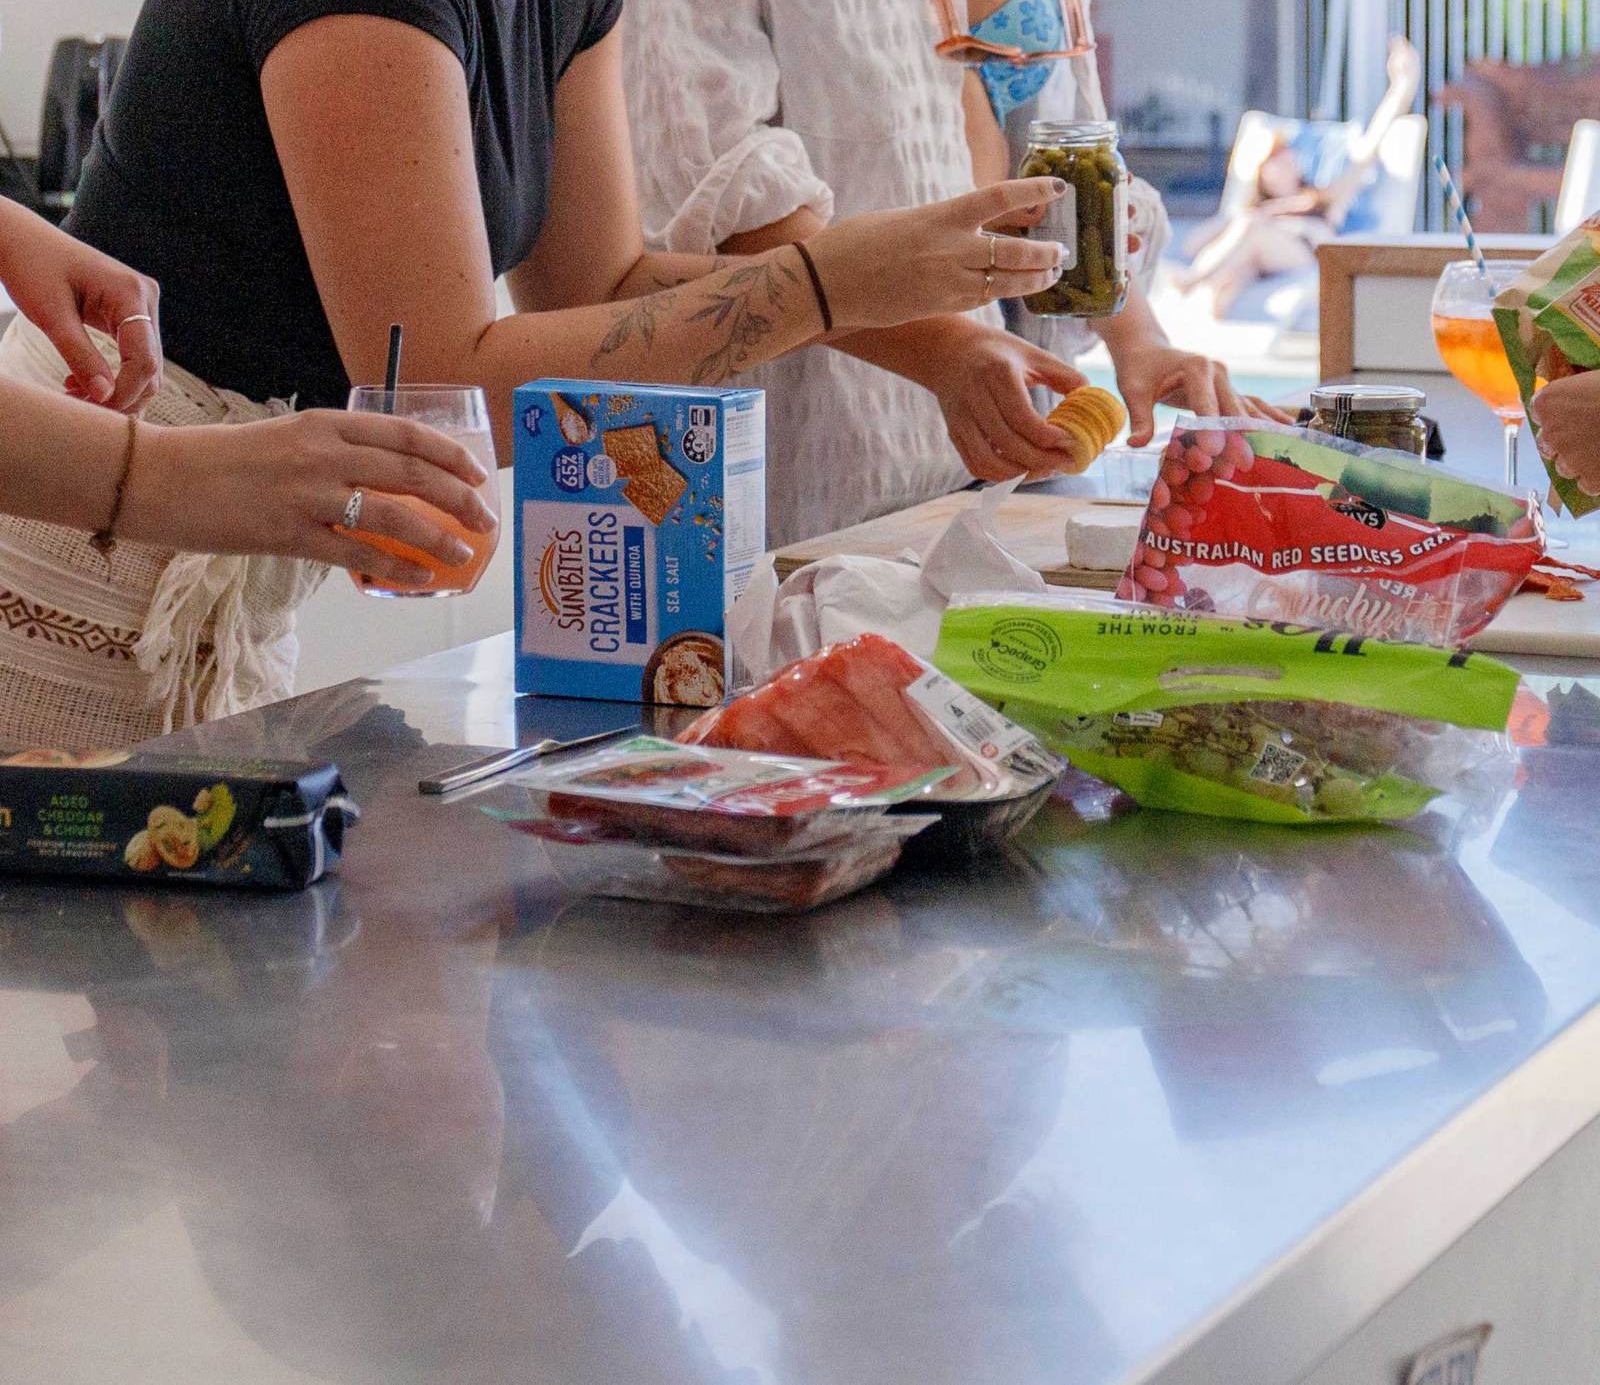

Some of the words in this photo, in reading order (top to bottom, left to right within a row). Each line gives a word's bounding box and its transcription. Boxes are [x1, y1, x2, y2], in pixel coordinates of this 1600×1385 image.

[561, 454, 578, 487] 65%
[1145, 532, 1264, 568] AUSTRALIAN
[1272, 547, 1303, 569] RED
[1310, 544, 1404, 566] SEEDLESS
[1409, 533, 1456, 556] GRA
[556, 530, 585, 632] SUNBITES
[628, 545, 642, 589] QUINOA
[665, 555, 680, 585] SALT
[588, 512, 620, 653] CRACKERS
[630, 592, 642, 621] WITH
[666, 590, 680, 613] SEA
[1097, 622, 1132, 635] THE
[1142, 623, 1197, 636] FROM
[37, 808, 104, 823] CHEDDAR
[50, 795, 89, 809] AGED
[54, 823, 101, 837] CHIVES
